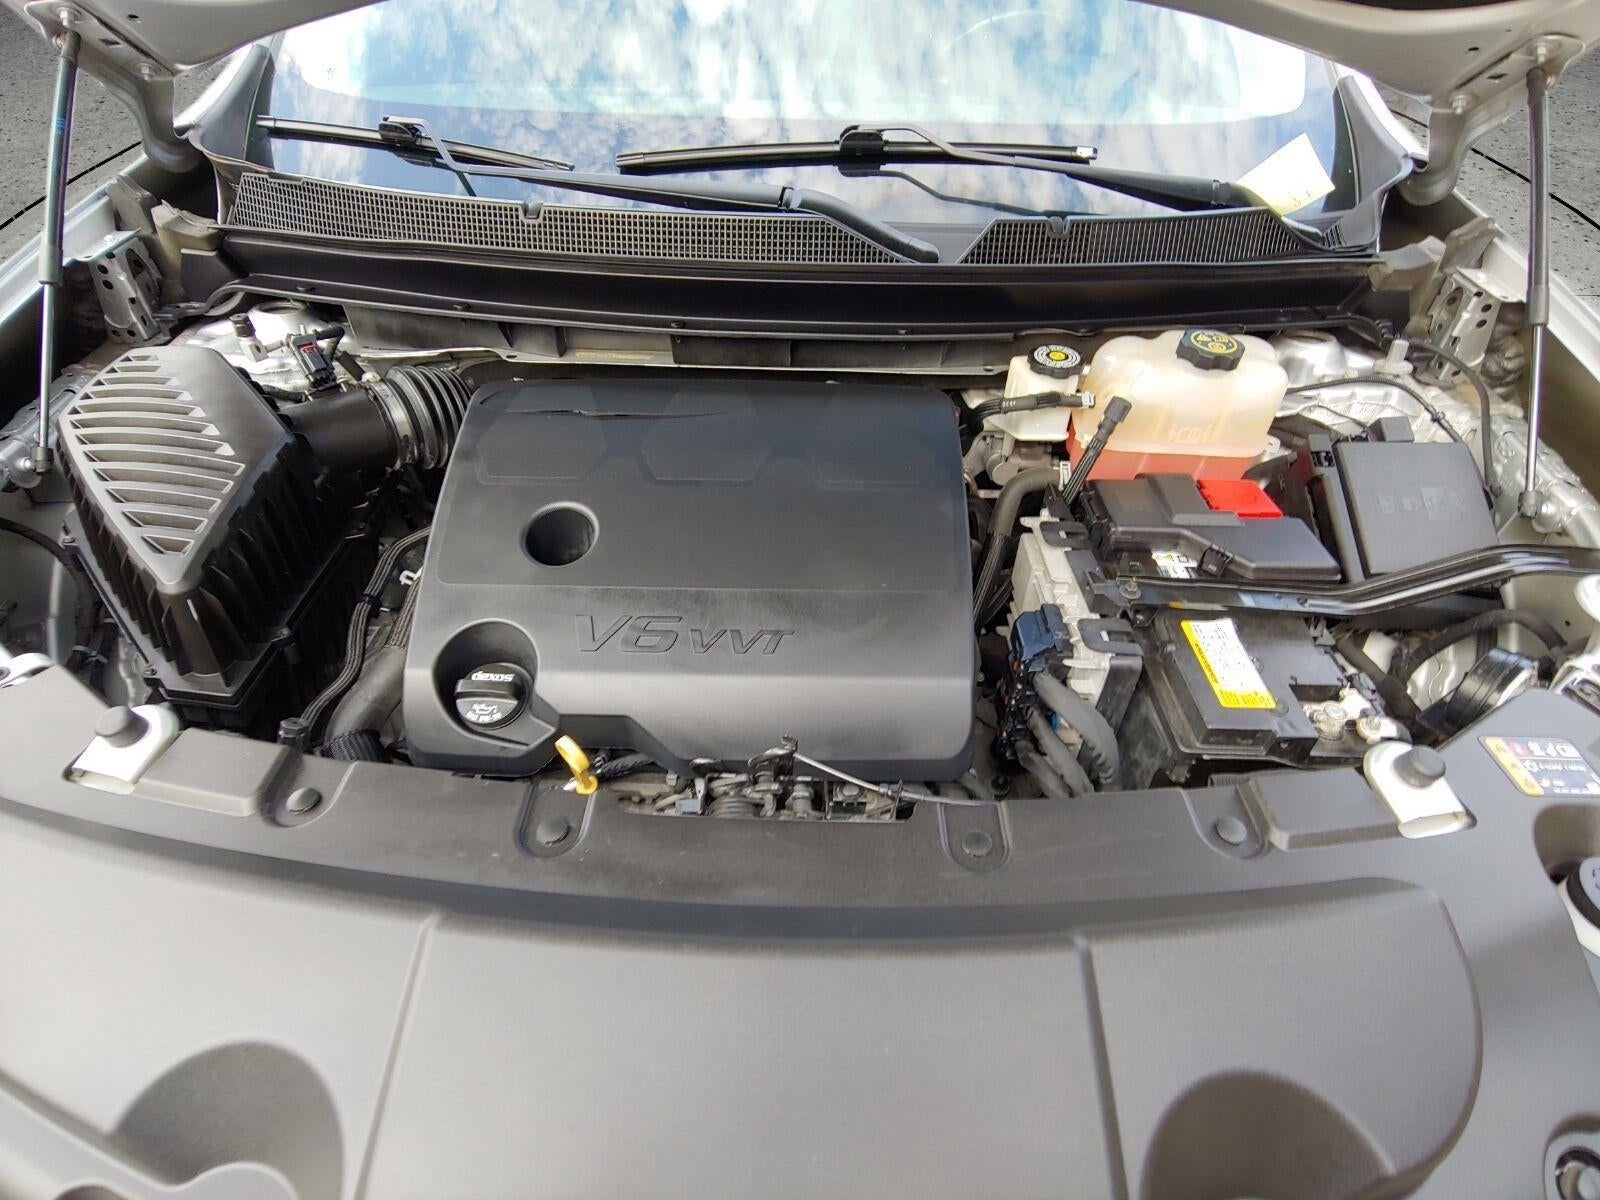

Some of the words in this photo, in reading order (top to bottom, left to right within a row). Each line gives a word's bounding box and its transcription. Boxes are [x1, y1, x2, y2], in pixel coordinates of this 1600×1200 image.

[576, 615, 683, 652] V6
[690, 628, 796, 654] VVT
[471, 671, 515, 682] dexos
